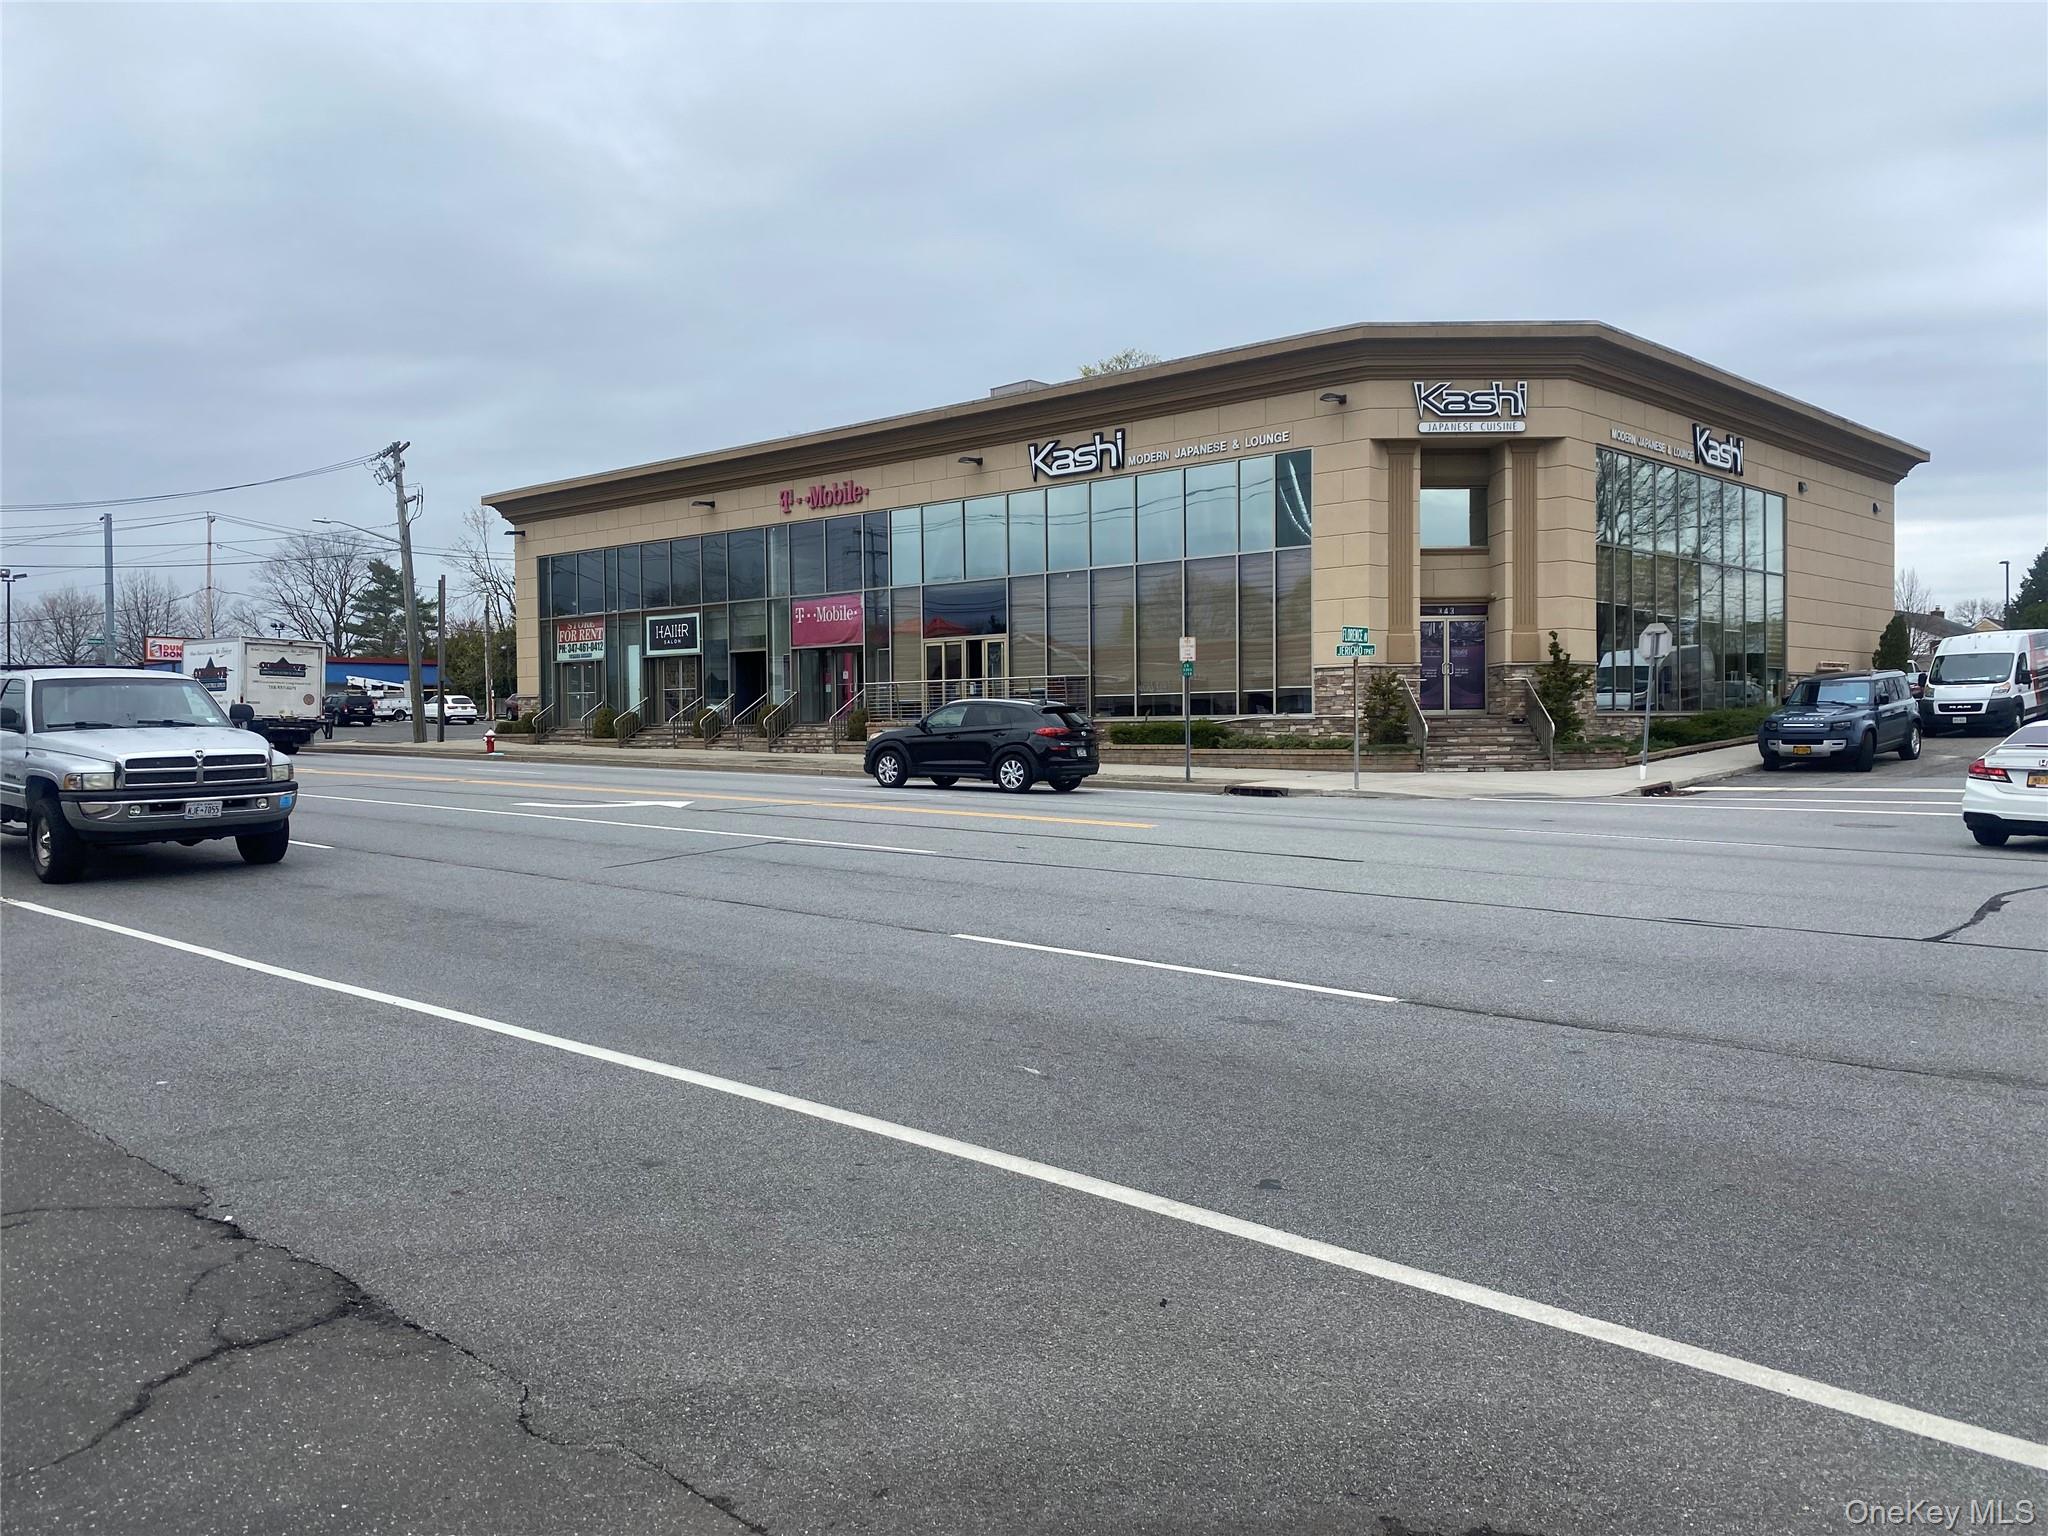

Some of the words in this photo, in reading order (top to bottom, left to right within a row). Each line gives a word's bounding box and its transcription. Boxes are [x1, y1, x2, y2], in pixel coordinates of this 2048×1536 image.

[1413, 381, 1527, 418] Kashi
[1427, 422, 1473, 432] JAPANESE
[1480, 421, 1518, 431] CUISINE
[1028, 428, 1125, 482] Kashi
[1128, 449, 1170, 467] MODERN
[1174, 440, 1227, 459] JAPANESE
[1232, 439, 1241, 450] &
[1245, 430, 1290, 448] LOUNGE
[1692, 423, 1744, 476] Kashi
[559, 630, 578, 642] FOR
[579, 627, 604, 641] RENT
[1337, 645, 1363, 656] JERICHO
